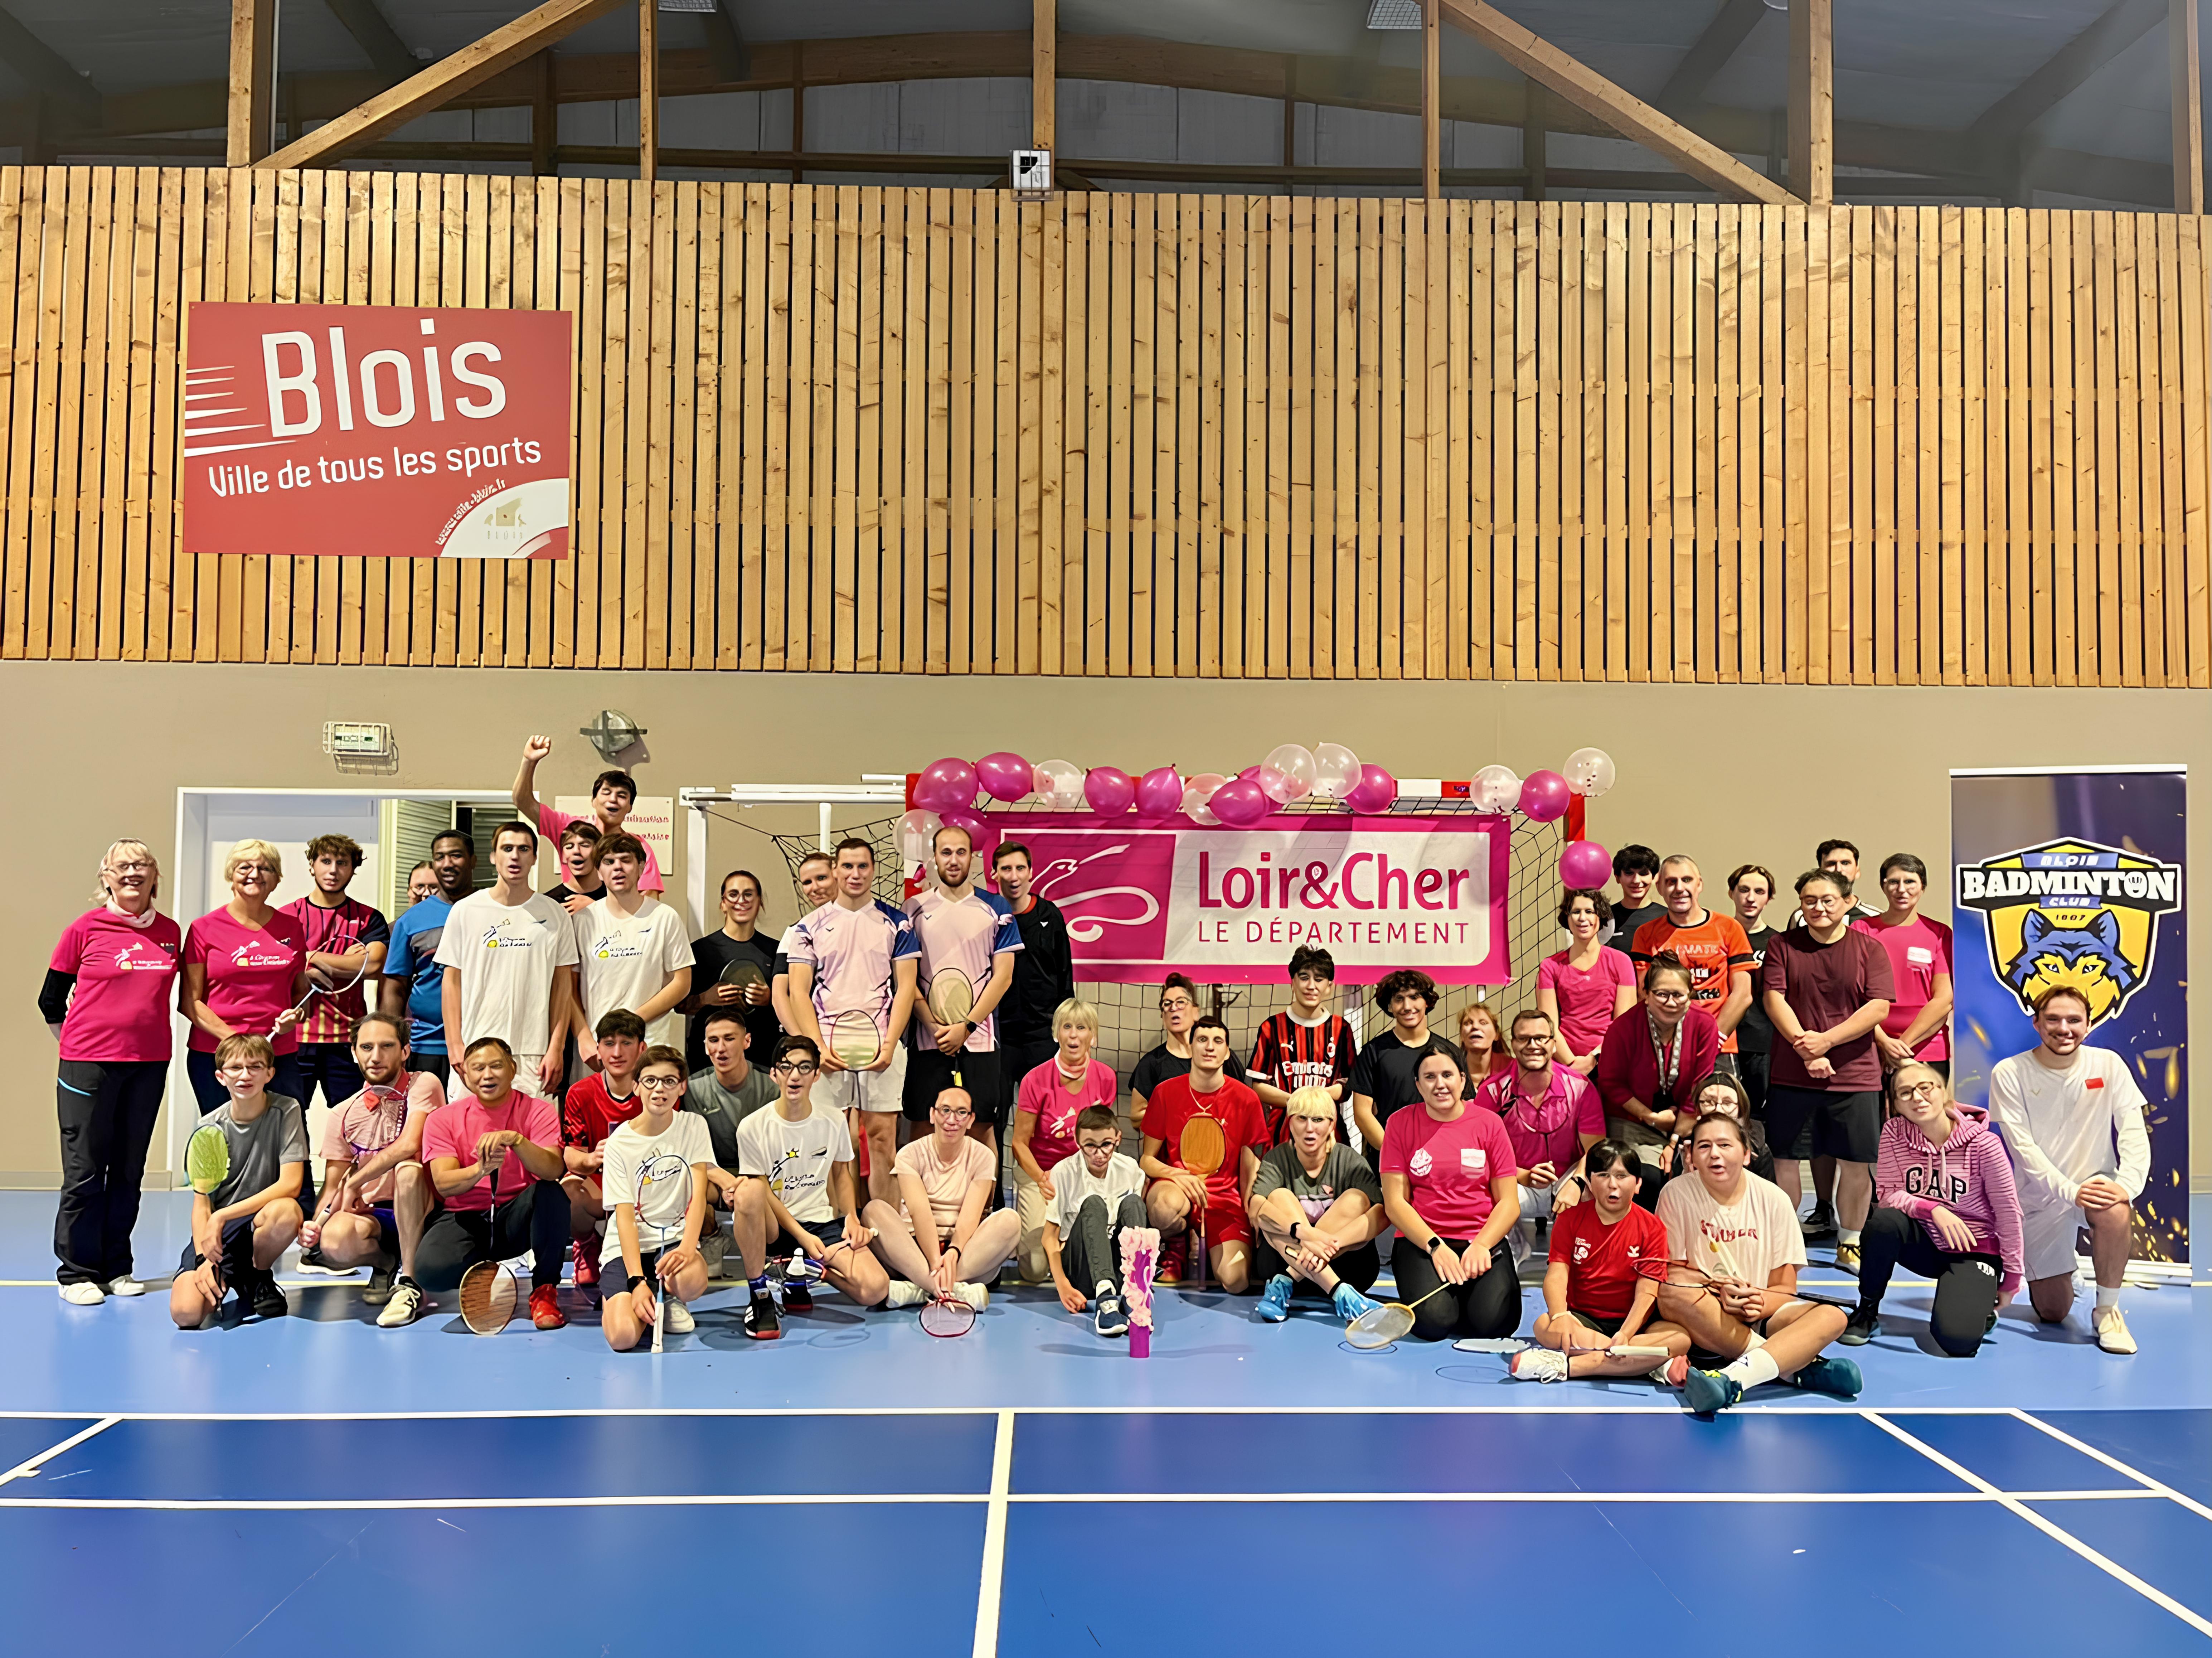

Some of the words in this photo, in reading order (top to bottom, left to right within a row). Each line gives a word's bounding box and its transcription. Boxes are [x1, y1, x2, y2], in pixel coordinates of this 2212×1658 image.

[262, 318, 506, 437] Blois
[209, 465, 270, 497] Ville
[278, 459, 311, 489] de
[317, 456, 384, 484] tous
[393, 446, 437, 476] les
[446, 437, 541, 477] sports
[1199, 851, 1470, 910] Loir&Cher
[1963, 871, 2175, 902] BADMINTON
[1199, 921, 1228, 942] LE
[1247, 916, 1468, 944] DÉPARTEMENT
[1906, 1166, 1966, 1204] GAP
